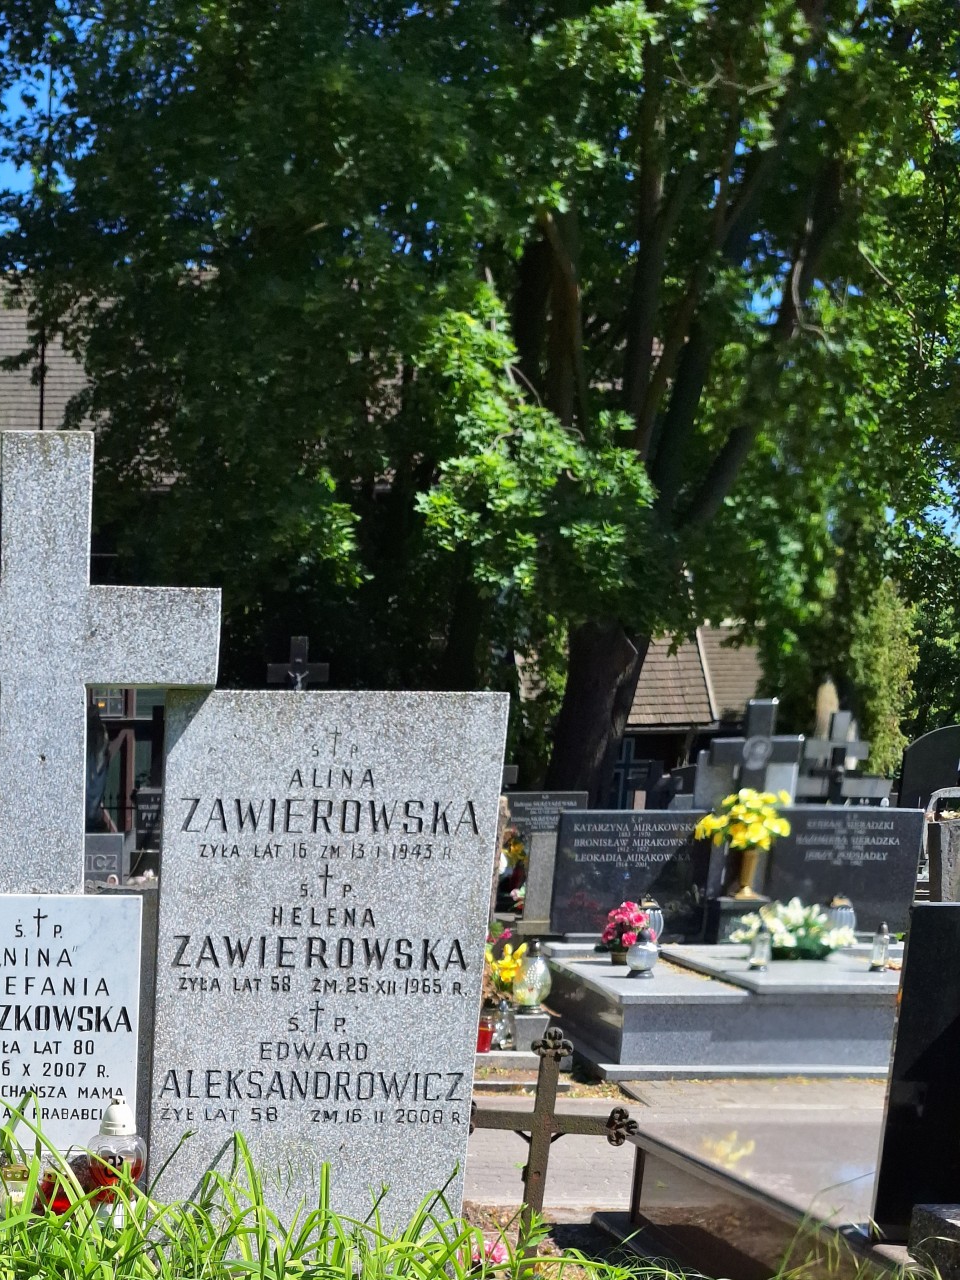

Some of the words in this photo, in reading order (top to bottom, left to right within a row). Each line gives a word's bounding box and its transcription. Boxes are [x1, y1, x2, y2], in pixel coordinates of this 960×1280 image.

[289, 768, 376, 789] ALINA
[179, 797, 480, 836] ZAWIEROWSKA
[573, 823, 629, 832] KATARZYNA
[292, 842, 307, 859] 16
[351, 842, 365, 860] 13
[392, 843, 433, 860] 1943
[574, 853, 622, 862] LEOKADIA
[271, 906, 376, 928] HELENA
[171, 934, 468, 971] ZAWIEROWSKA
[233, 976, 262, 993] LAT
[271, 974, 291, 992] 58
[33, 1040, 63, 1055] LAT
[73, 1039, 95, 1055] 80
[259, 1041, 369, 1062] EDWARD
[22, 1062, 31, 1077] X
[42, 1062, 87, 1078] 2007
[96, 1064, 110, 1078] R.
[77, 1086, 124, 1099] MAMA
[157, 1068, 465, 1102] ALEKSANDROWICZ
[205, 1107, 239, 1122] LAT
[250, 1106, 278, 1122] 58
